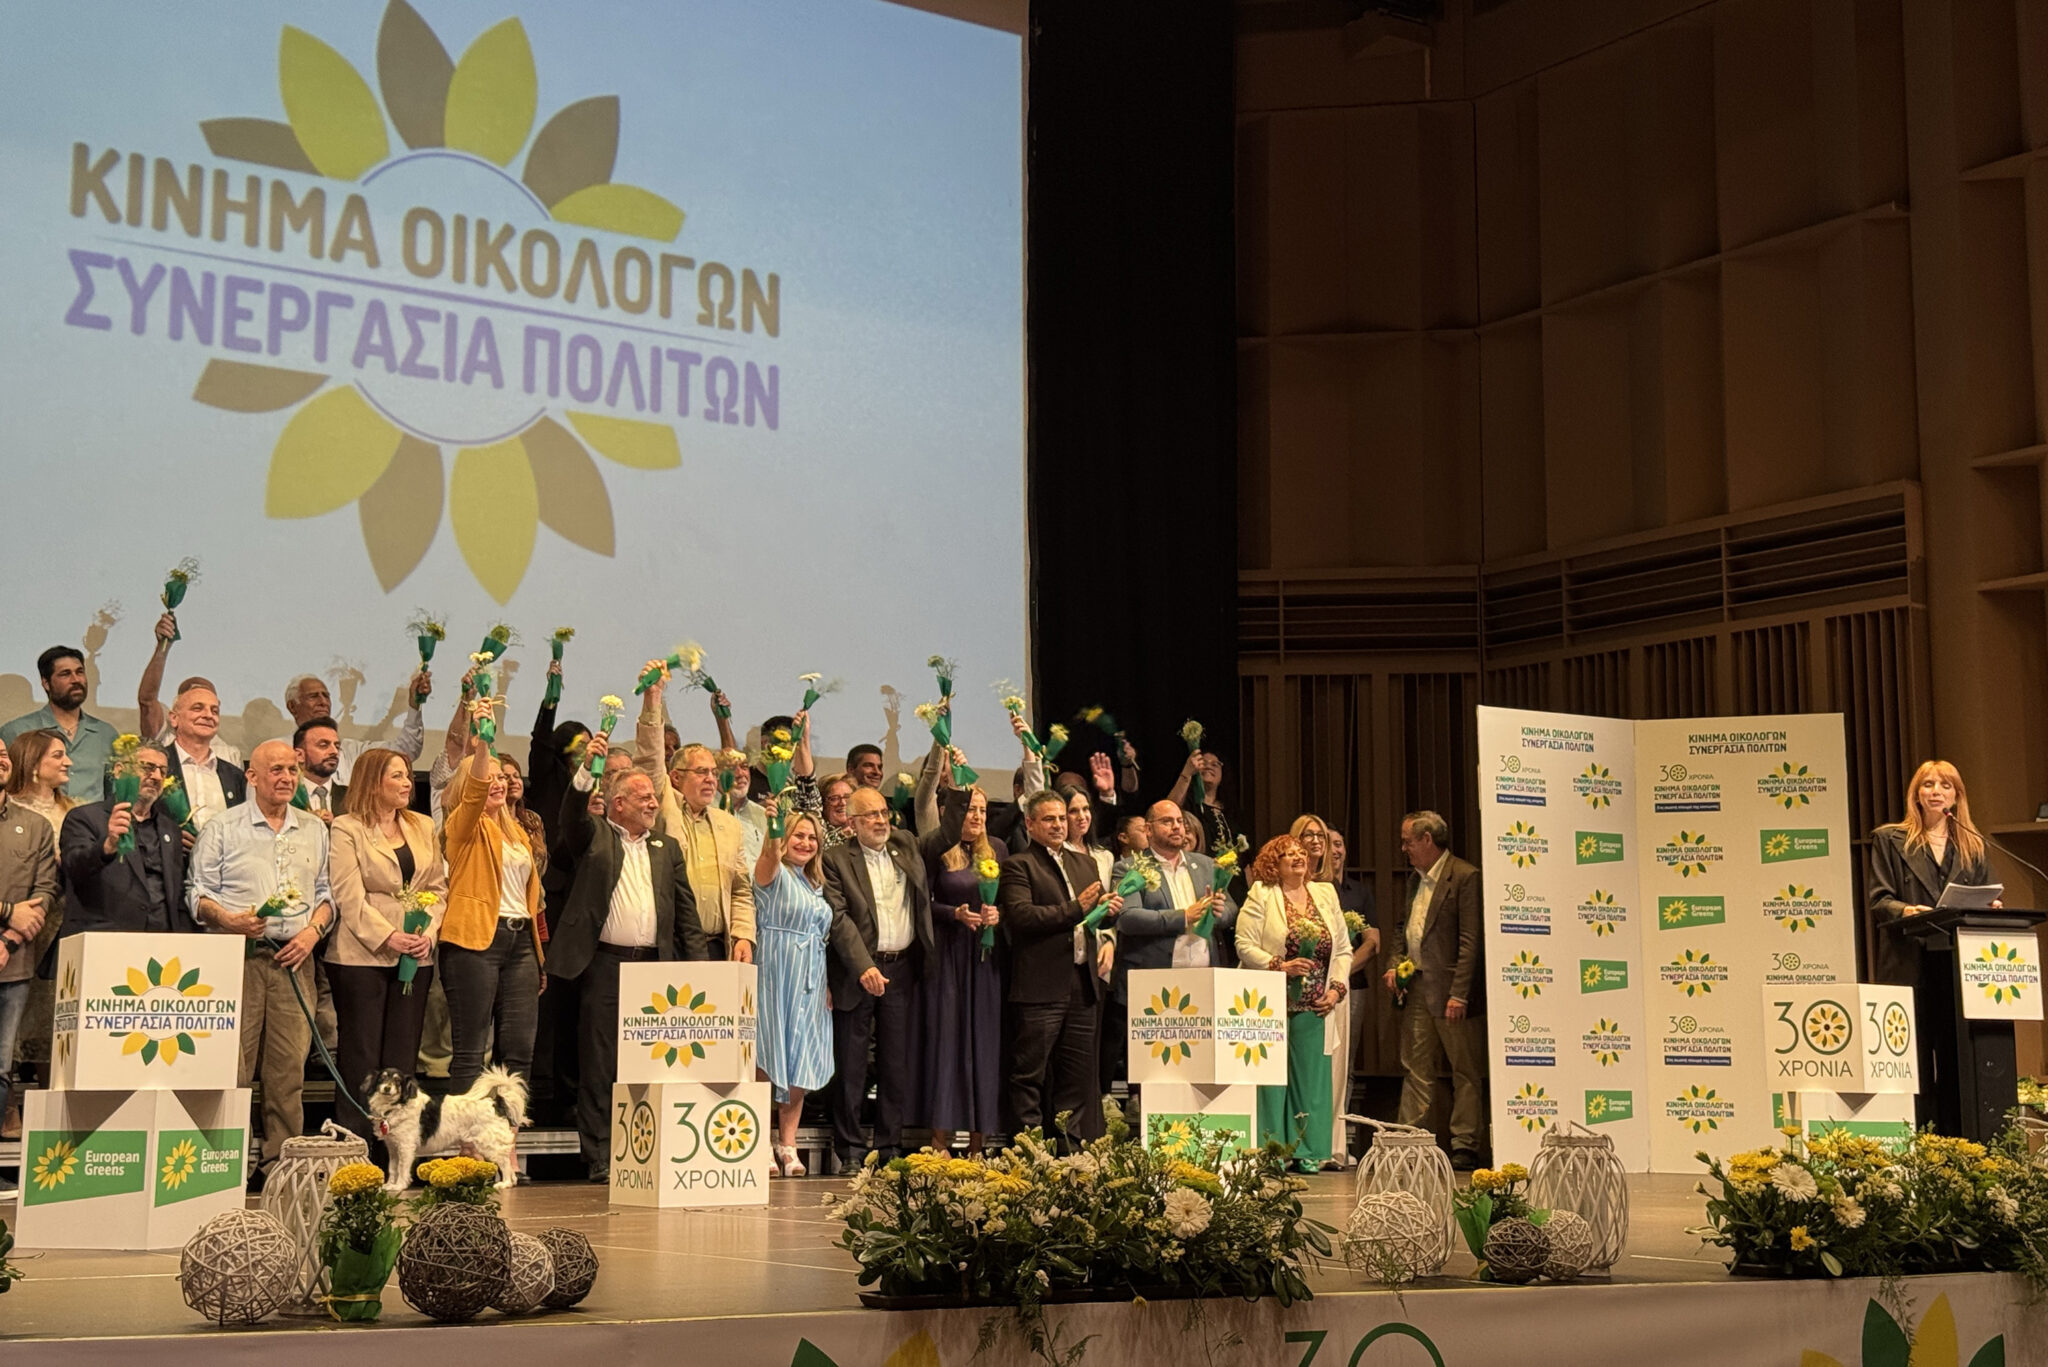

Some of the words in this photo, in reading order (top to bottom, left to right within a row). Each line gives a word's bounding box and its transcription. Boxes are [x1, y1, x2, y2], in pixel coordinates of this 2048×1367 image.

[70, 142, 379, 268] ΚΙΝΗΜΑ
[402, 207, 780, 338] ΟΙΚΟΛΟΓΩΝ
[64, 249, 504, 389] ΣΥΝΕΡΓΑΣΙΑ
[523, 326, 779, 430] ΠΟΛΙΤΩΝ
[1521, 726, 1550, 738] ΚΙΝΗΜΑ
[1552, 729, 1593, 741] ΟΙΚΟΛΟΓΩΝ
[1689, 734, 1727, 743] ΚΙΝΗΜΑ
[1729, 731, 1786, 742] ΟΙΚΟΛΟΓΩΝ
[1522, 739, 1563, 750] ΣΥΝΕΡΓΑΣΙΑ
[1565, 741, 1594, 753] ΠΟΛΙΤΩΝ
[1689, 745, 1745, 755] ΣΥΝΕΡΓΑΣΙΑ
[1747, 743, 1786, 753] ΠΟΛΙΤΩΝ
[1500, 755, 1521, 773] 30
[1659, 764, 1687, 782] 30
[1654, 784, 1680, 792] ΚΙΝΗΜΑ
[1786, 777, 1826, 785] ΟΙΚΟΛΟΓΩΝ
[1654, 792, 1692, 801] ΣΥΝΕΡΓΑΣΙΑ
[1794, 837, 1826, 846] European
[1504, 884, 1525, 902] 30
[1772, 952, 1801, 971] 30
[1964, 963, 1993, 972] ΚΙΝΗΜΑ
[1995, 963, 2037, 972] ΟΙΚΟΛΟΓΩΝ
[1965, 974, 2007, 983] ΣΥΝΕΡΓΑΣΙΑ
[2009, 974, 2038, 983] ΠΟΛΙΤΩΝ
[86, 999, 147, 1012] ΚΙΝΗΜΑ
[151, 999, 236, 1013] ΟΙΚΟΛΟΓΩΝ
[85, 1016, 172, 1030] ΣΥΝΕΡΓΑΣΙΑ
[176, 1016, 235, 1030] ΠΟΛΙΤΩΝ
[624, 1016, 667, 1027] ΚΙΝΗΜΑ
[671, 1016, 734, 1027] ΟΙΚΟΛΟΓΩΝ
[1131, 1017, 1162, 1027] ΚΙΝΗΜΑ
[1164, 1017, 1212, 1026] ΟΙΚΟΛΟΓΩΝ
[1217, 1017, 1244, 1027] ΚΙΝΗΜΑ
[1246, 1018, 1283, 1028] ΟΙΚΟΛΟΓΩΝ
[1508, 1015, 1530, 1034] 30
[1669, 1016, 1697, 1034] 30
[1774, 1000, 1853, 1055] 30
[624, 1029, 687, 1040] ΣΥΝΕΡΓΑΣΙΑ
[689, 1029, 734, 1039] ΠΟΛΙΤΩΝ
[1132, 1030, 1177, 1040] ΣΥΝΕΡΓΑΣΙΑ
[1179, 1030, 1212, 1039] ΠΟΛΙΤΩΝ
[1217, 1030, 1256, 1040] ΣΥΝΕΡΓΑΣΙΑ
[1258, 1031, 1284, 1041] ΠΟΛΙΤΩΝ
[1866, 1002, 1910, 1056] 30
[1779, 1060, 1853, 1077] ΧΡΟΝΙΑ
[1871, 1061, 1912, 1078] ΧΡΟΝΙΑ
[615, 1101, 656, 1164] 30
[671, 1099, 760, 1164] 30
[85, 1150, 140, 1165] European
[201, 1149, 239, 1161] European
[85, 1163, 125, 1176] Greens
[201, 1160, 229, 1173] Greens
[616, 1169, 653, 1190] ΧΡΟΝΙΑ
[674, 1169, 757, 1190] ΧΡΟΝΙΑ
